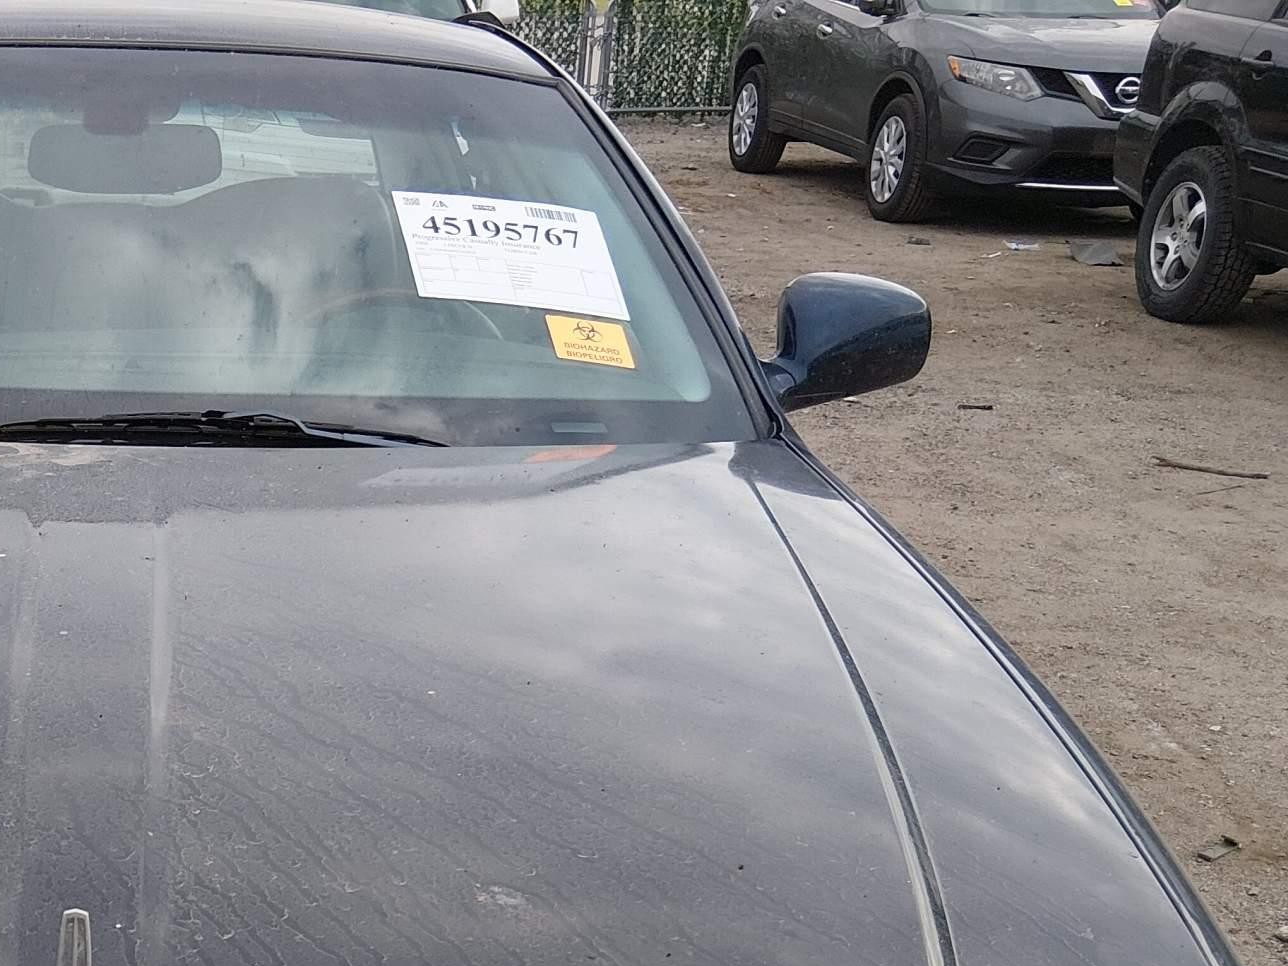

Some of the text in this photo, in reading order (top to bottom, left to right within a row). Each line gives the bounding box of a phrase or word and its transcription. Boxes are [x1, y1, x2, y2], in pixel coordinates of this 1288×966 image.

[422, 215, 579, 249] 45195767
[412, 233, 461, 242] Progressive
[462, 236, 499, 246] Casualty
[563, 342, 621, 356] BIOHAZARD
[566, 350, 623, 364] BIOPELIGRO
